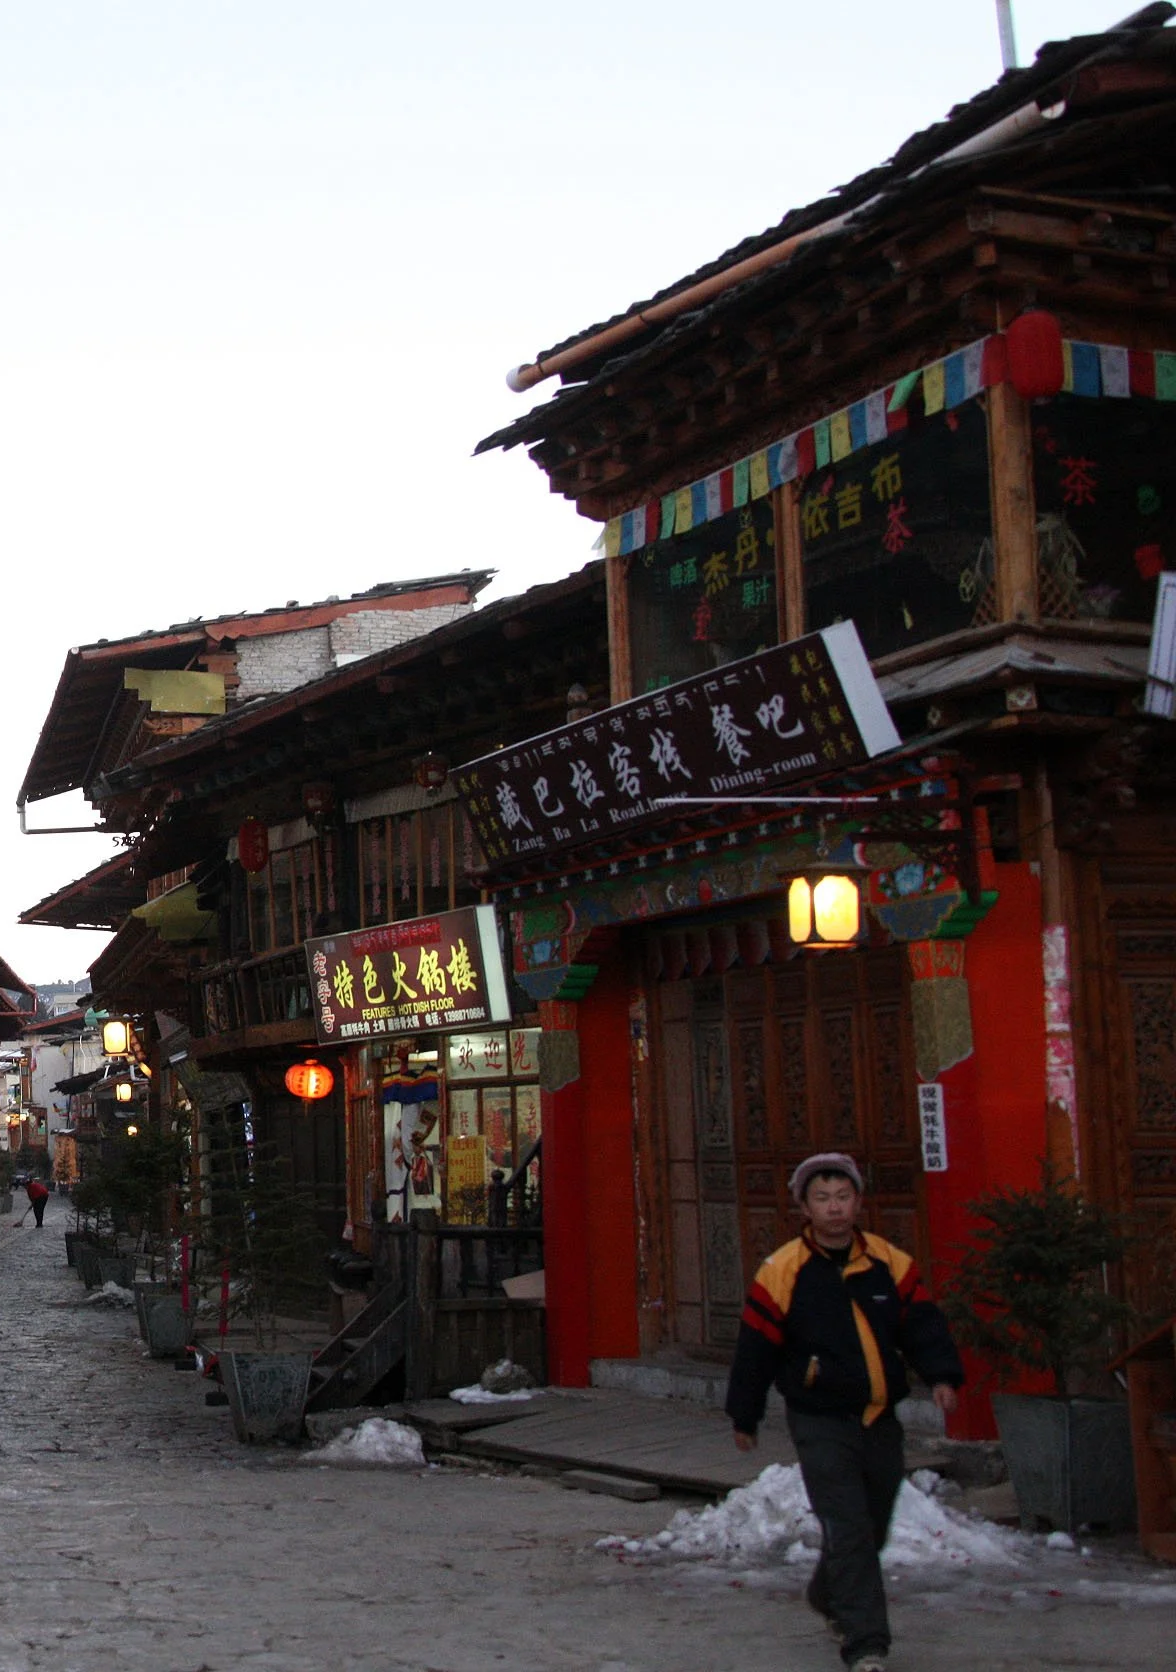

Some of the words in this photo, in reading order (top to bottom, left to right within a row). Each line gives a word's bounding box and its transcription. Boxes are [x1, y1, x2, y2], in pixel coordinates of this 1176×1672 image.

[1058, 456, 1096, 506] 茶
[742, 575, 770, 609] 果汁
[494, 727, 693, 832] 藏巴拉客栈
[710, 693, 805, 767] 餐吧
[511, 834, 546, 854] Zang
[553, 824, 572, 842] Ba
[581, 816, 601, 833] La
[709, 751, 817, 794] Dining-room
[312, 950, 336, 1034] 老字号
[333, 938, 478, 1009] 特色火锅楼
[362, 1004, 396, 1021] FEATURES
[399, 1003, 413, 1016] HOT
[413, 1000, 430, 1014] DISH
[430, 997, 455, 1012] FLOOR
